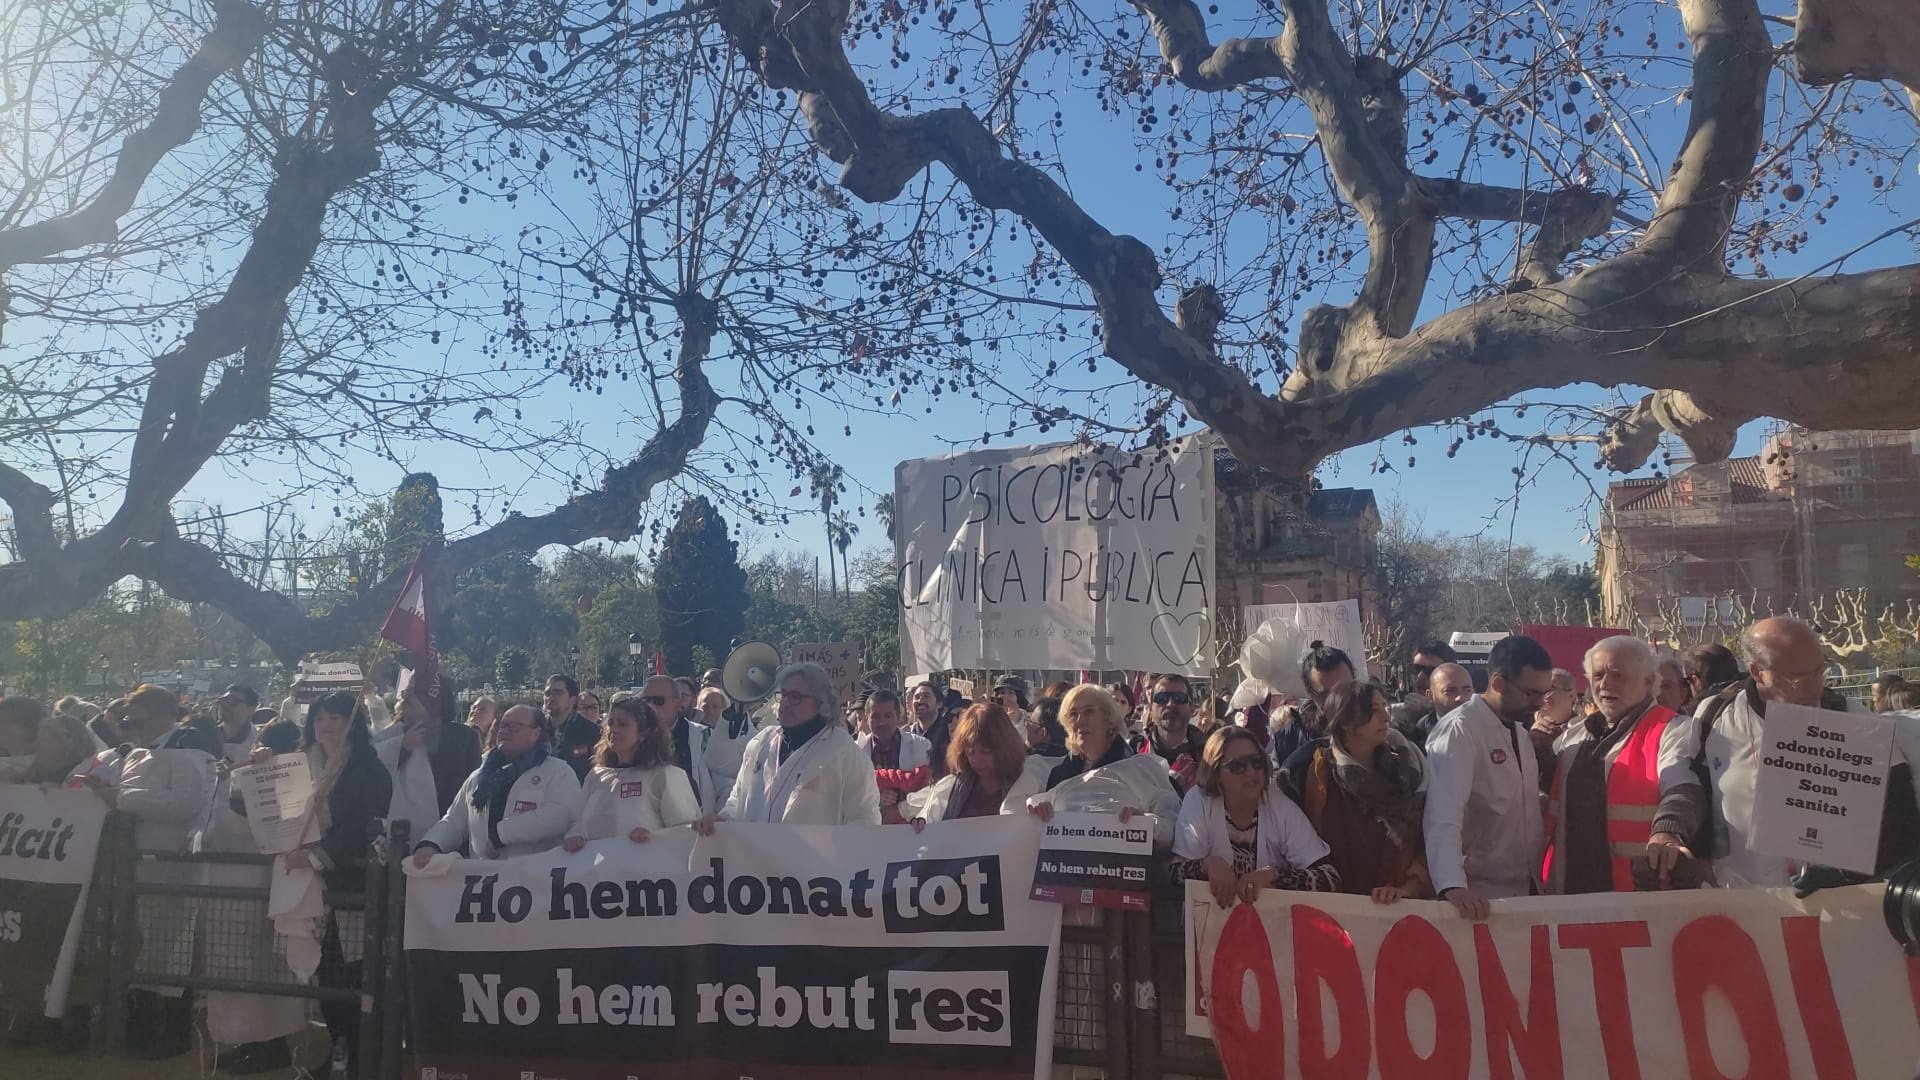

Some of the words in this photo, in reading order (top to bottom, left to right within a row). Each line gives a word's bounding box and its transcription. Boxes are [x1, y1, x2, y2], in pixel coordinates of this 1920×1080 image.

[1806, 725, 1846, 743] Som
[1776, 740, 1873, 766] odontòlegs
[1763, 756, 1882, 786] odontòlogues
[1798, 779, 1838, 796] Som
[1785, 797, 1848, 816] sanitat
[1046, 826, 1059, 836] Ho
[1061, 826, 1085, 837] hem
[1088, 827, 1125, 839] donat
[1127, 830, 1145, 841] tot
[1040, 862, 1057, 873] No
[1059, 862, 1084, 874] hem
[1086, 864, 1122, 877] rebut
[1124, 868, 1144, 879] res
[455, 873, 533, 923] Ho
[549, 867, 678, 920] hem
[687, 857, 875, 919] donat
[892, 861, 990, 919] tot
[458, 973, 541, 1026] No
[556, 967, 676, 1026] hem
[696, 966, 876, 1031] rebut
[893, 987, 1005, 1033] res
